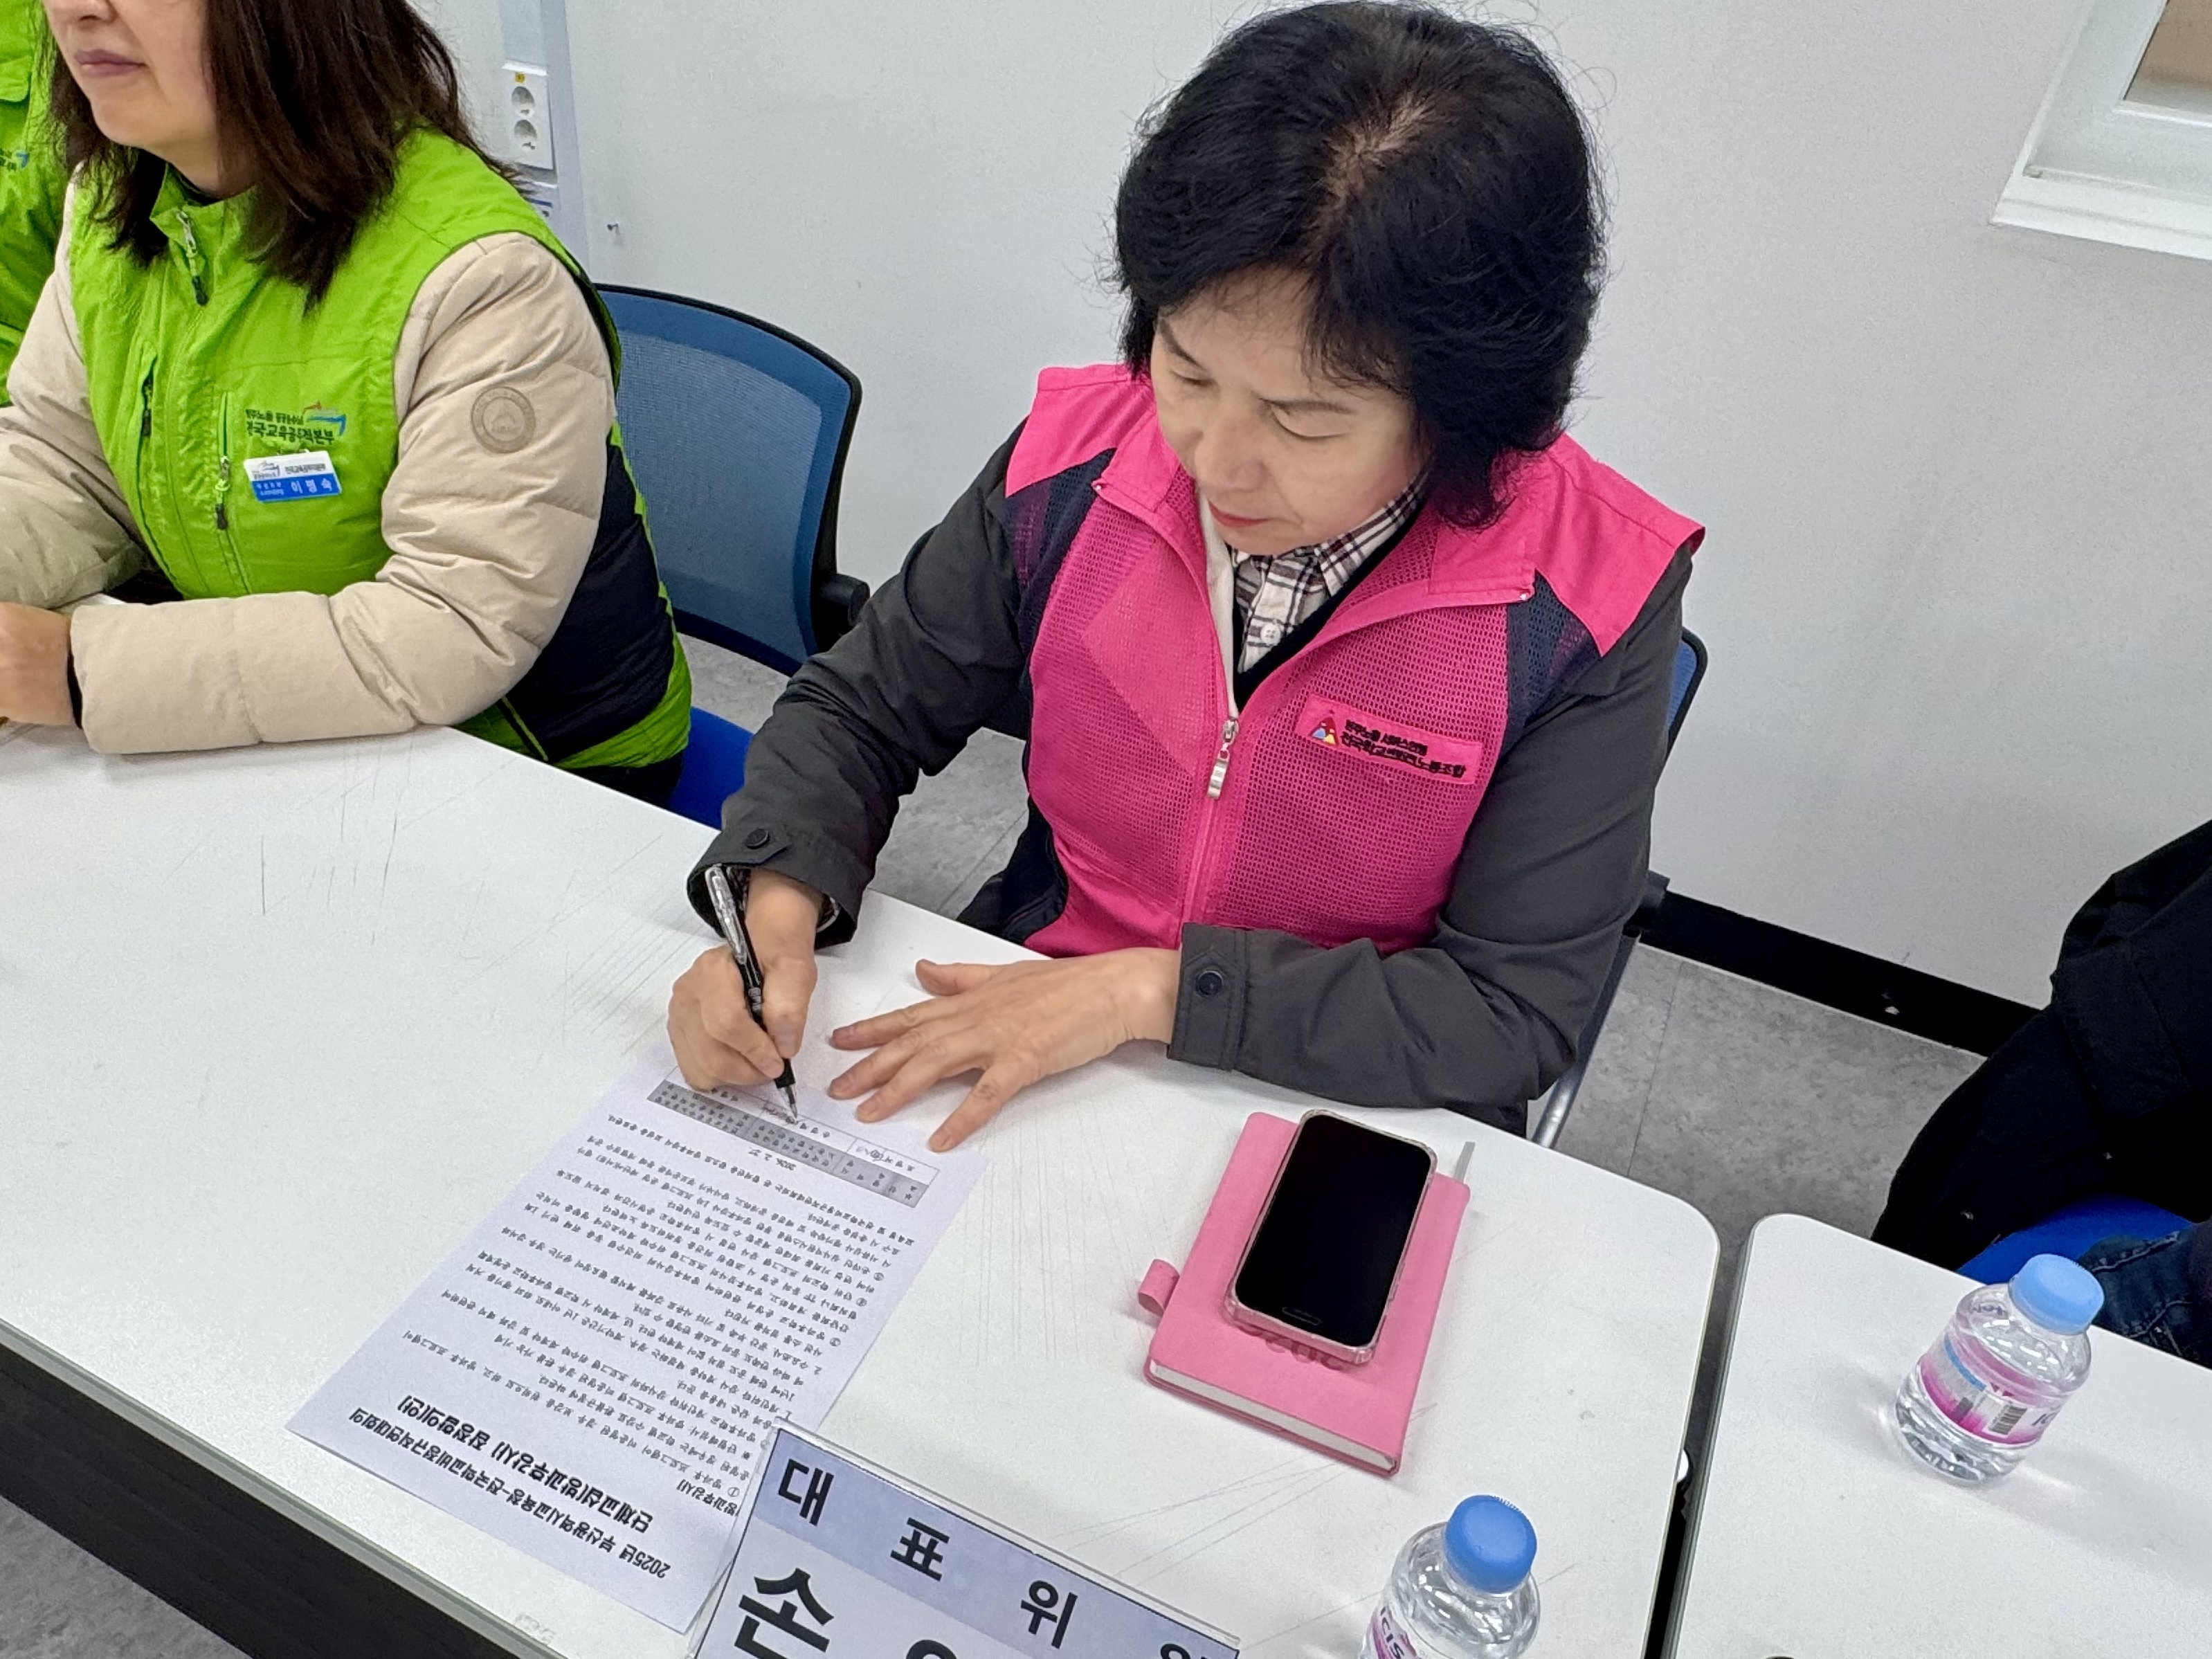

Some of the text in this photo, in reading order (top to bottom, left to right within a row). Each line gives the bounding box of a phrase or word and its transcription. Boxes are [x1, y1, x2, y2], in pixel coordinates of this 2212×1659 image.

[348, 1406, 671, 1579] 2025년 부산광역시교육청-전국학교비정규직연대회의
[397, 1395, 653, 1534] 단체교섭(방과후강사) 잠정합의(안)
[732, 1567, 835, 1659] 손
[775, 1457, 1078, 1650] 대 표 위
